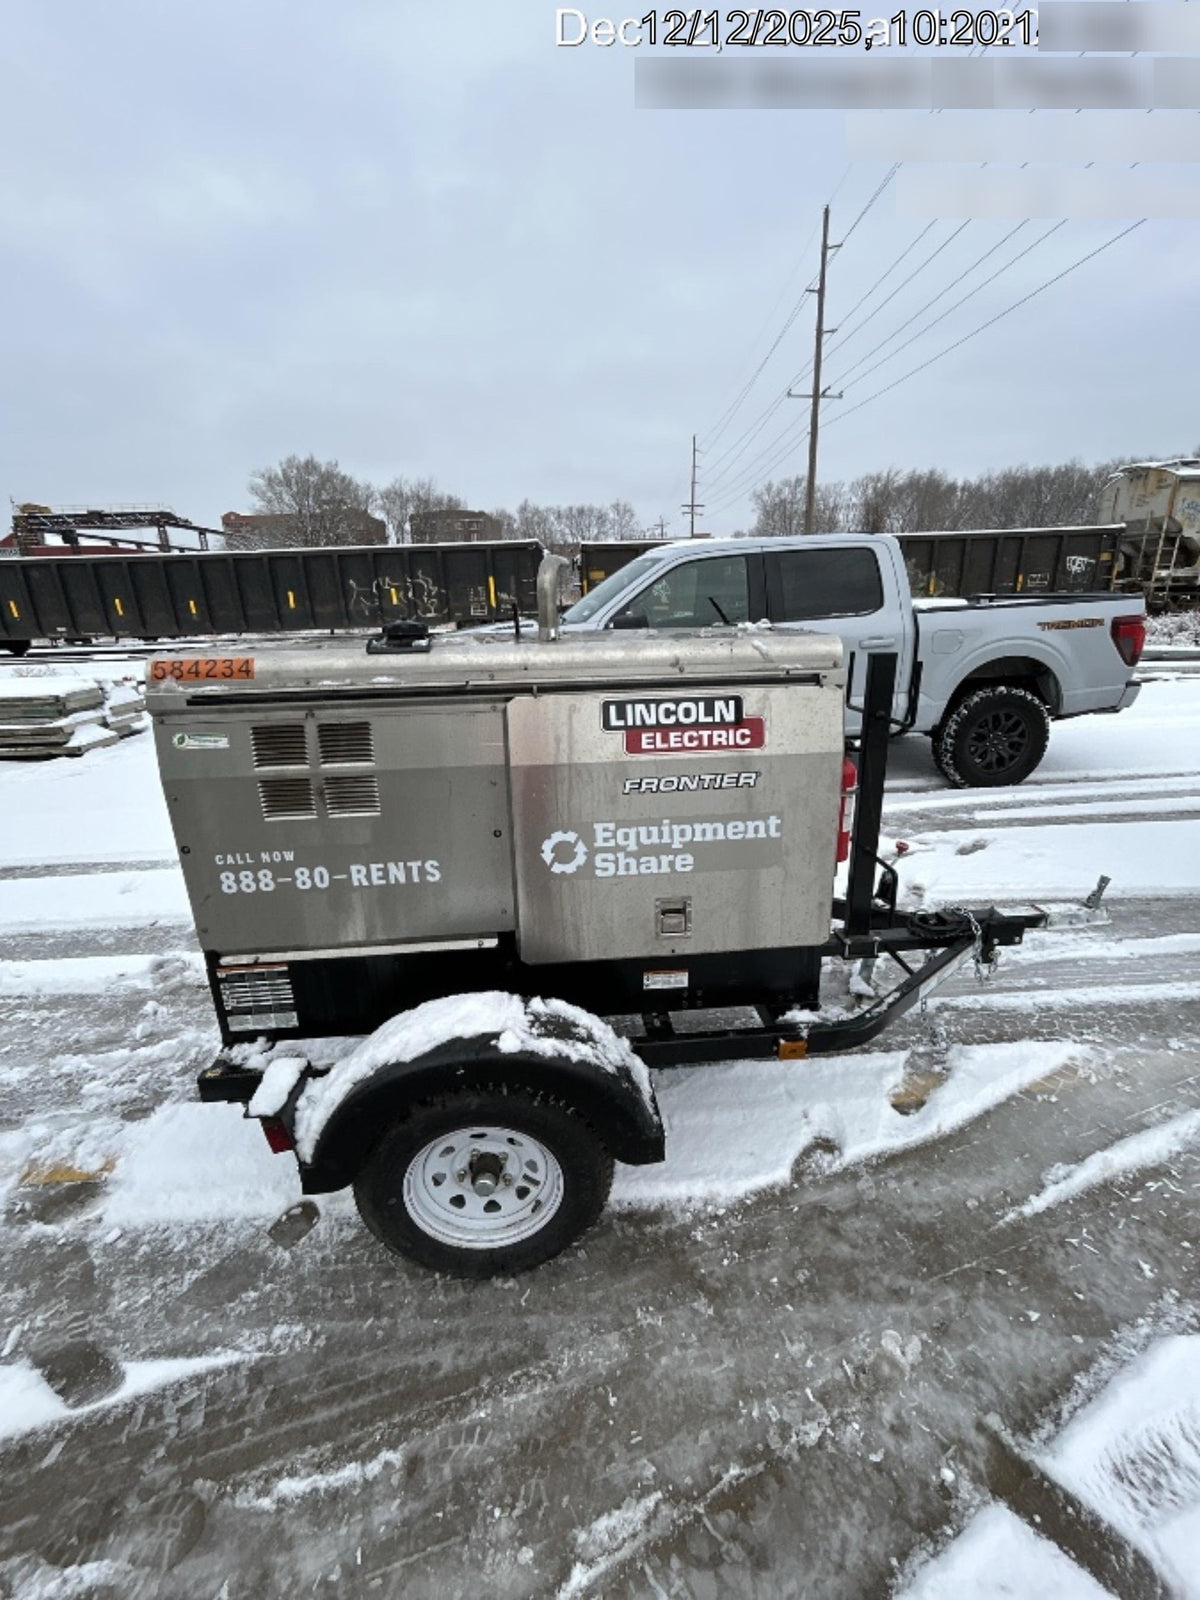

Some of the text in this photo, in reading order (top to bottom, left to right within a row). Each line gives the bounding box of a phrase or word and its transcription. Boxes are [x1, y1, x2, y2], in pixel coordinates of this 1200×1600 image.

[153, 659, 251, 680] 584234
[608, 700, 736, 728] LINCOLN
[640, 727, 752, 751] ELECTRIC
[623, 772, 759, 795] FRONTIER
[593, 815, 781, 850] Equipment
[215, 850, 296, 866] CALL NOW
[594, 852, 695, 878] Share
[220, 860, 442, 894] 888-80-RENTS
